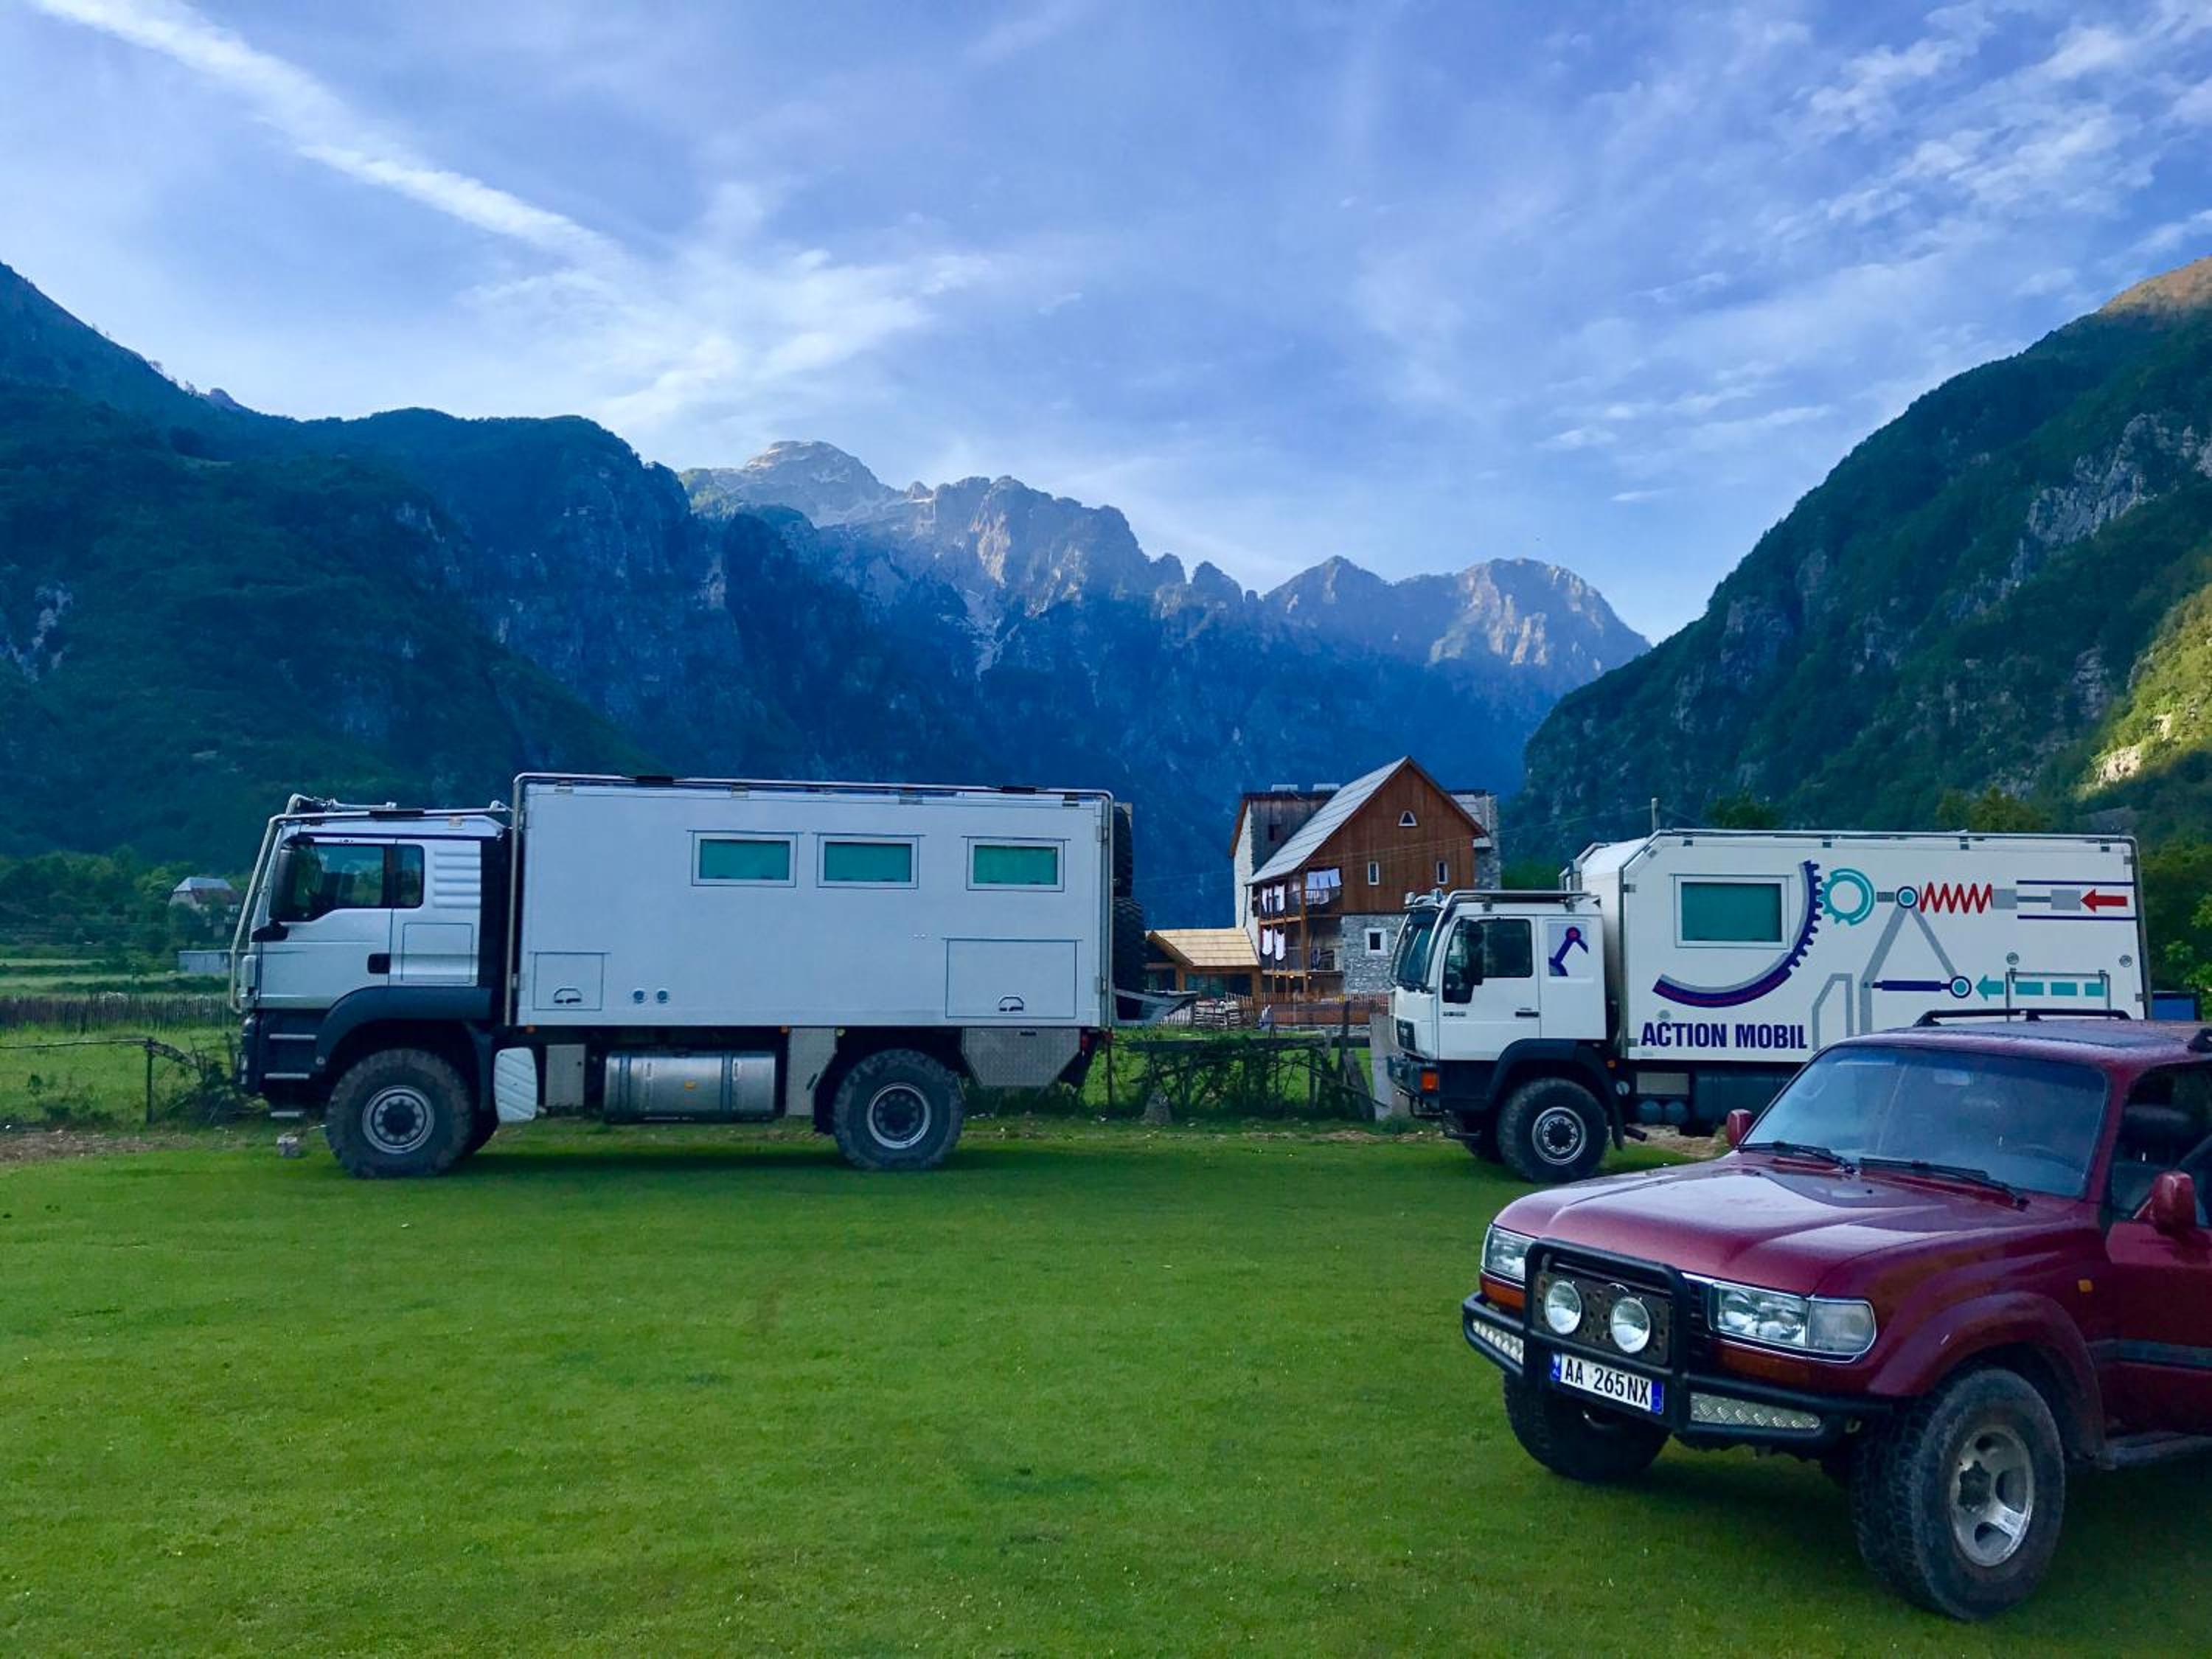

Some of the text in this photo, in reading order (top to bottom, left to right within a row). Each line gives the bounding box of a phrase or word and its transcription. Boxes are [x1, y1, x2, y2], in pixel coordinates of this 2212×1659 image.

[1641, 1022, 1808, 1048] ACTION MOBIL
[1565, 1358, 1584, 1385] AA
